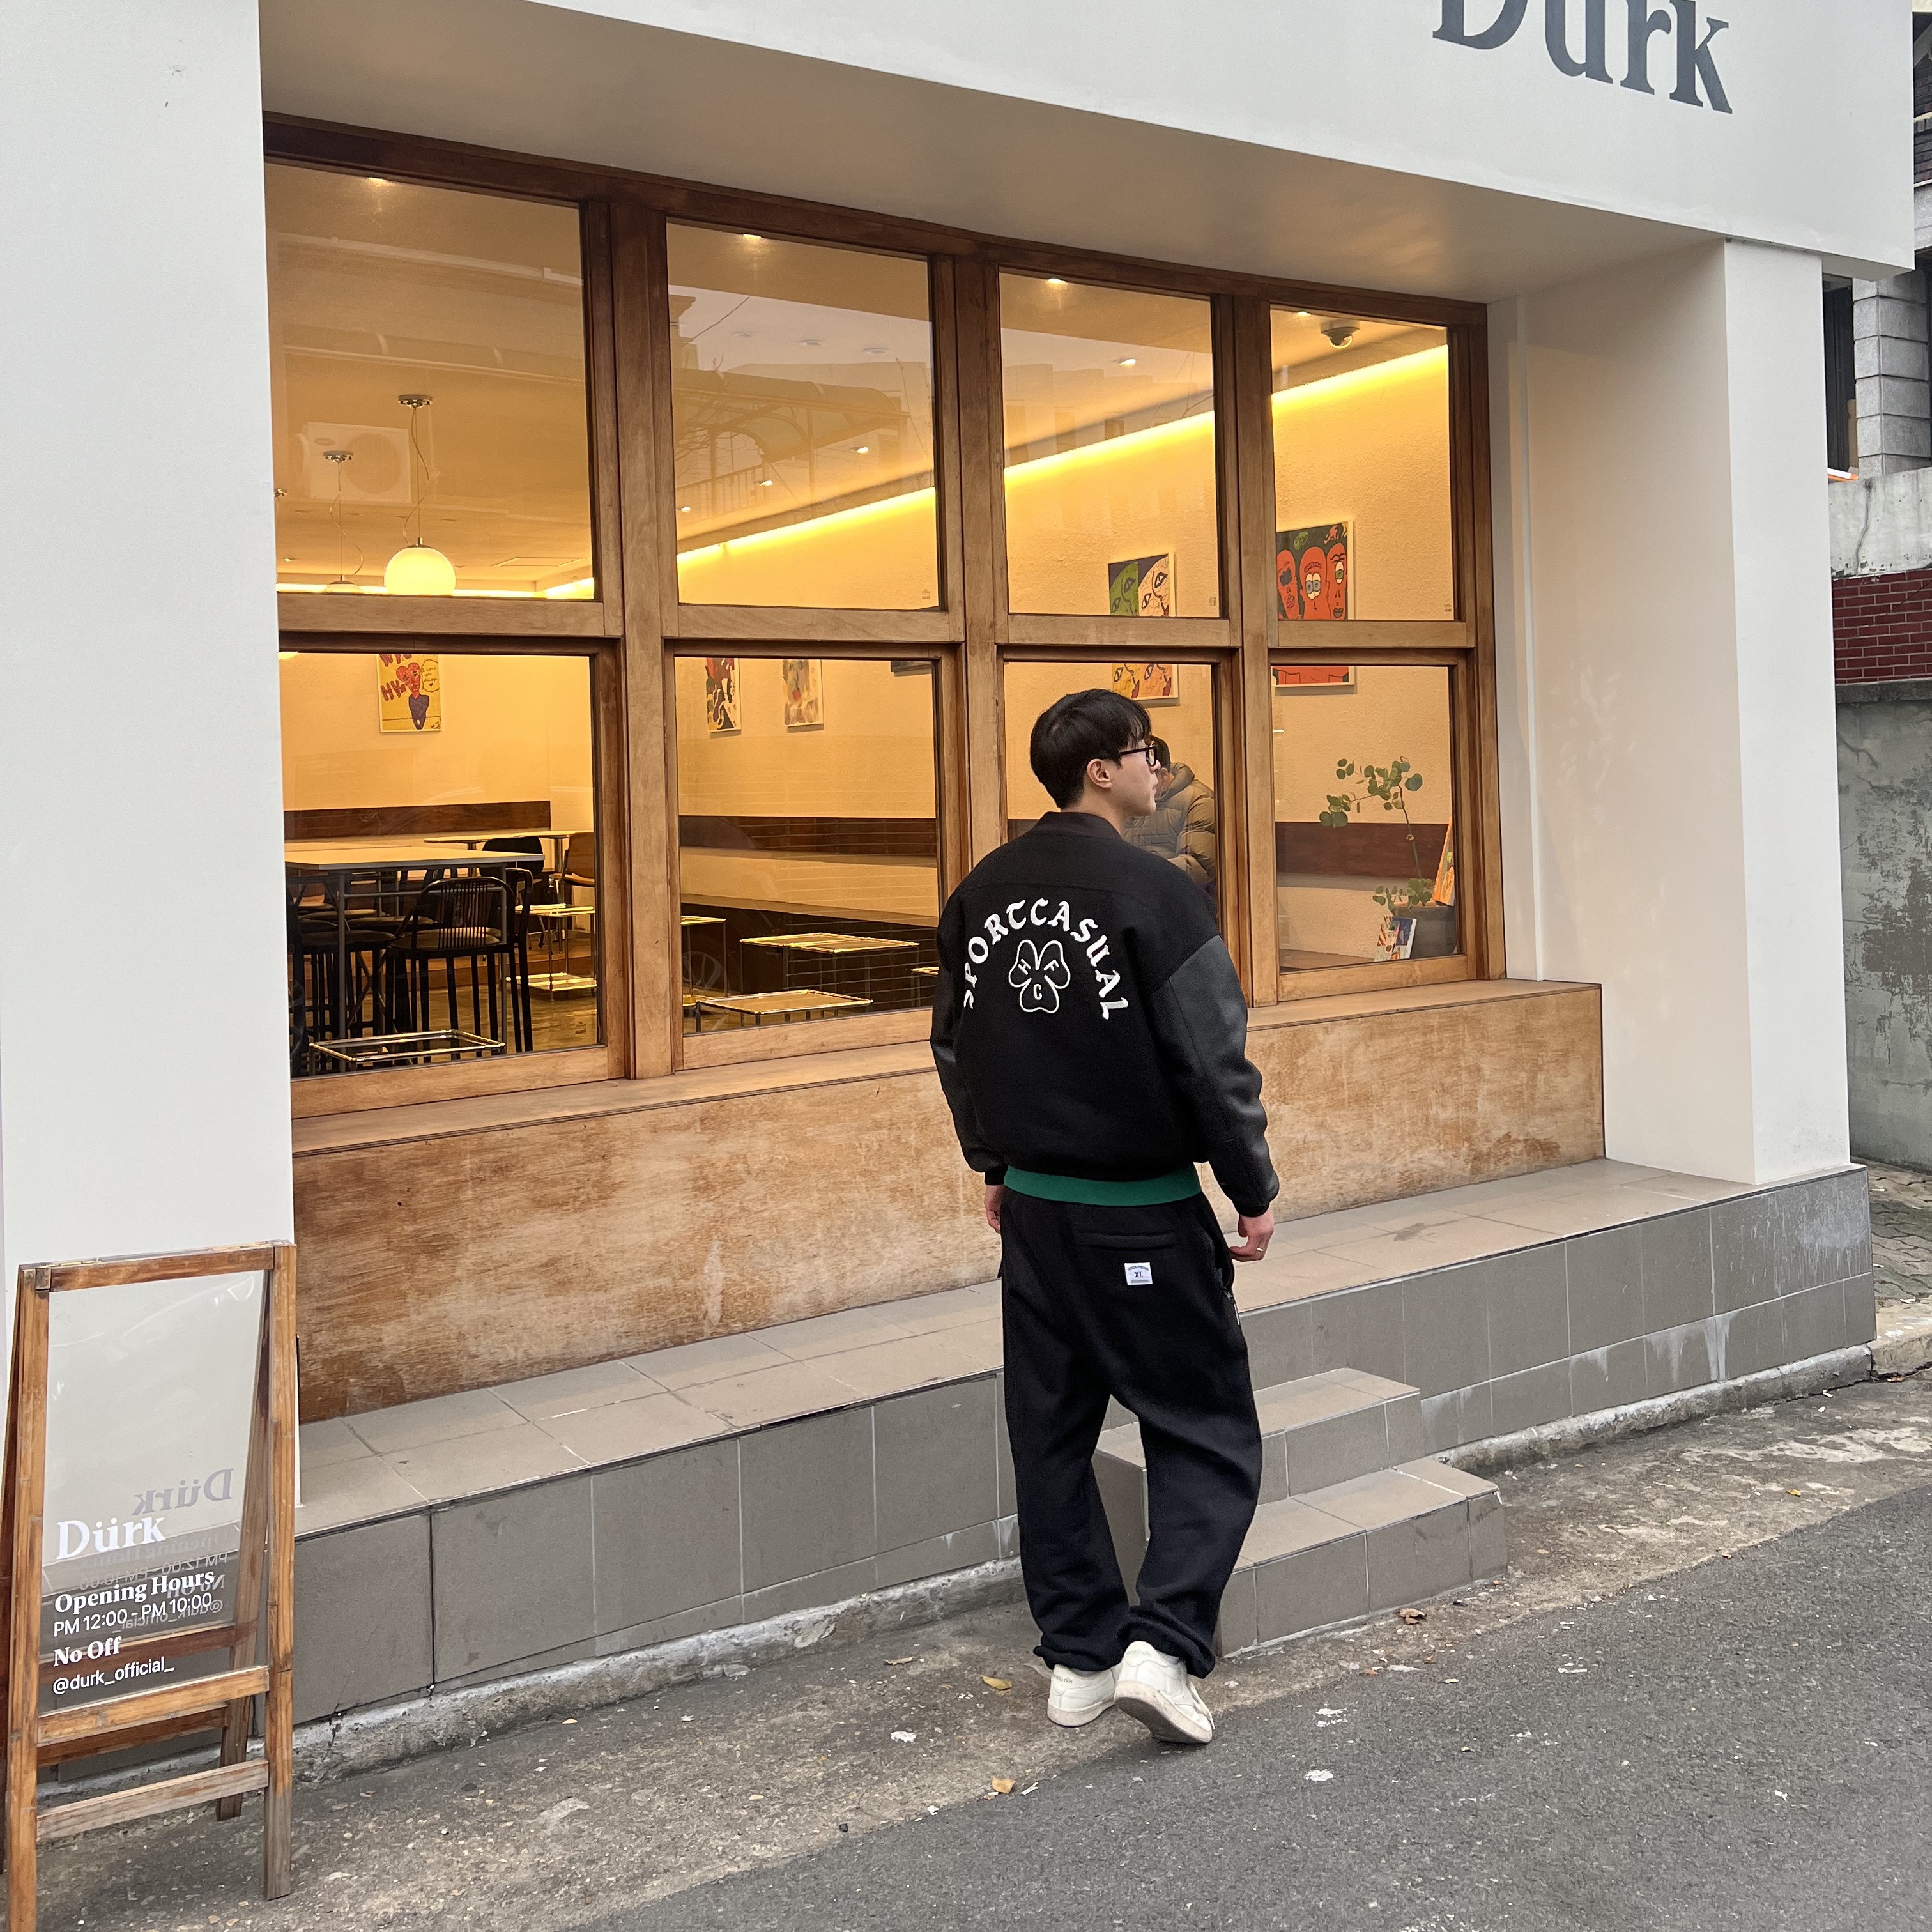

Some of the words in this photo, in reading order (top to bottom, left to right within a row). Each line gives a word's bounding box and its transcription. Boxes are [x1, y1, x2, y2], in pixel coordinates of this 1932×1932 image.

[57, 1517, 165, 1560] Dürk
[55, 1584, 148, 1614] Opening
[151, 1571, 214, 1595] Hours
[54, 1617, 79, 1637] PM
[82, 1609, 128, 1630] 12:00
[142, 1601, 166, 1620] PM
[169, 1592, 212, 1614] 10:00
[53, 1646, 82, 1667] No
[87, 1636, 122, 1659] Off
[53, 1656, 175, 1695] @durk_official_
